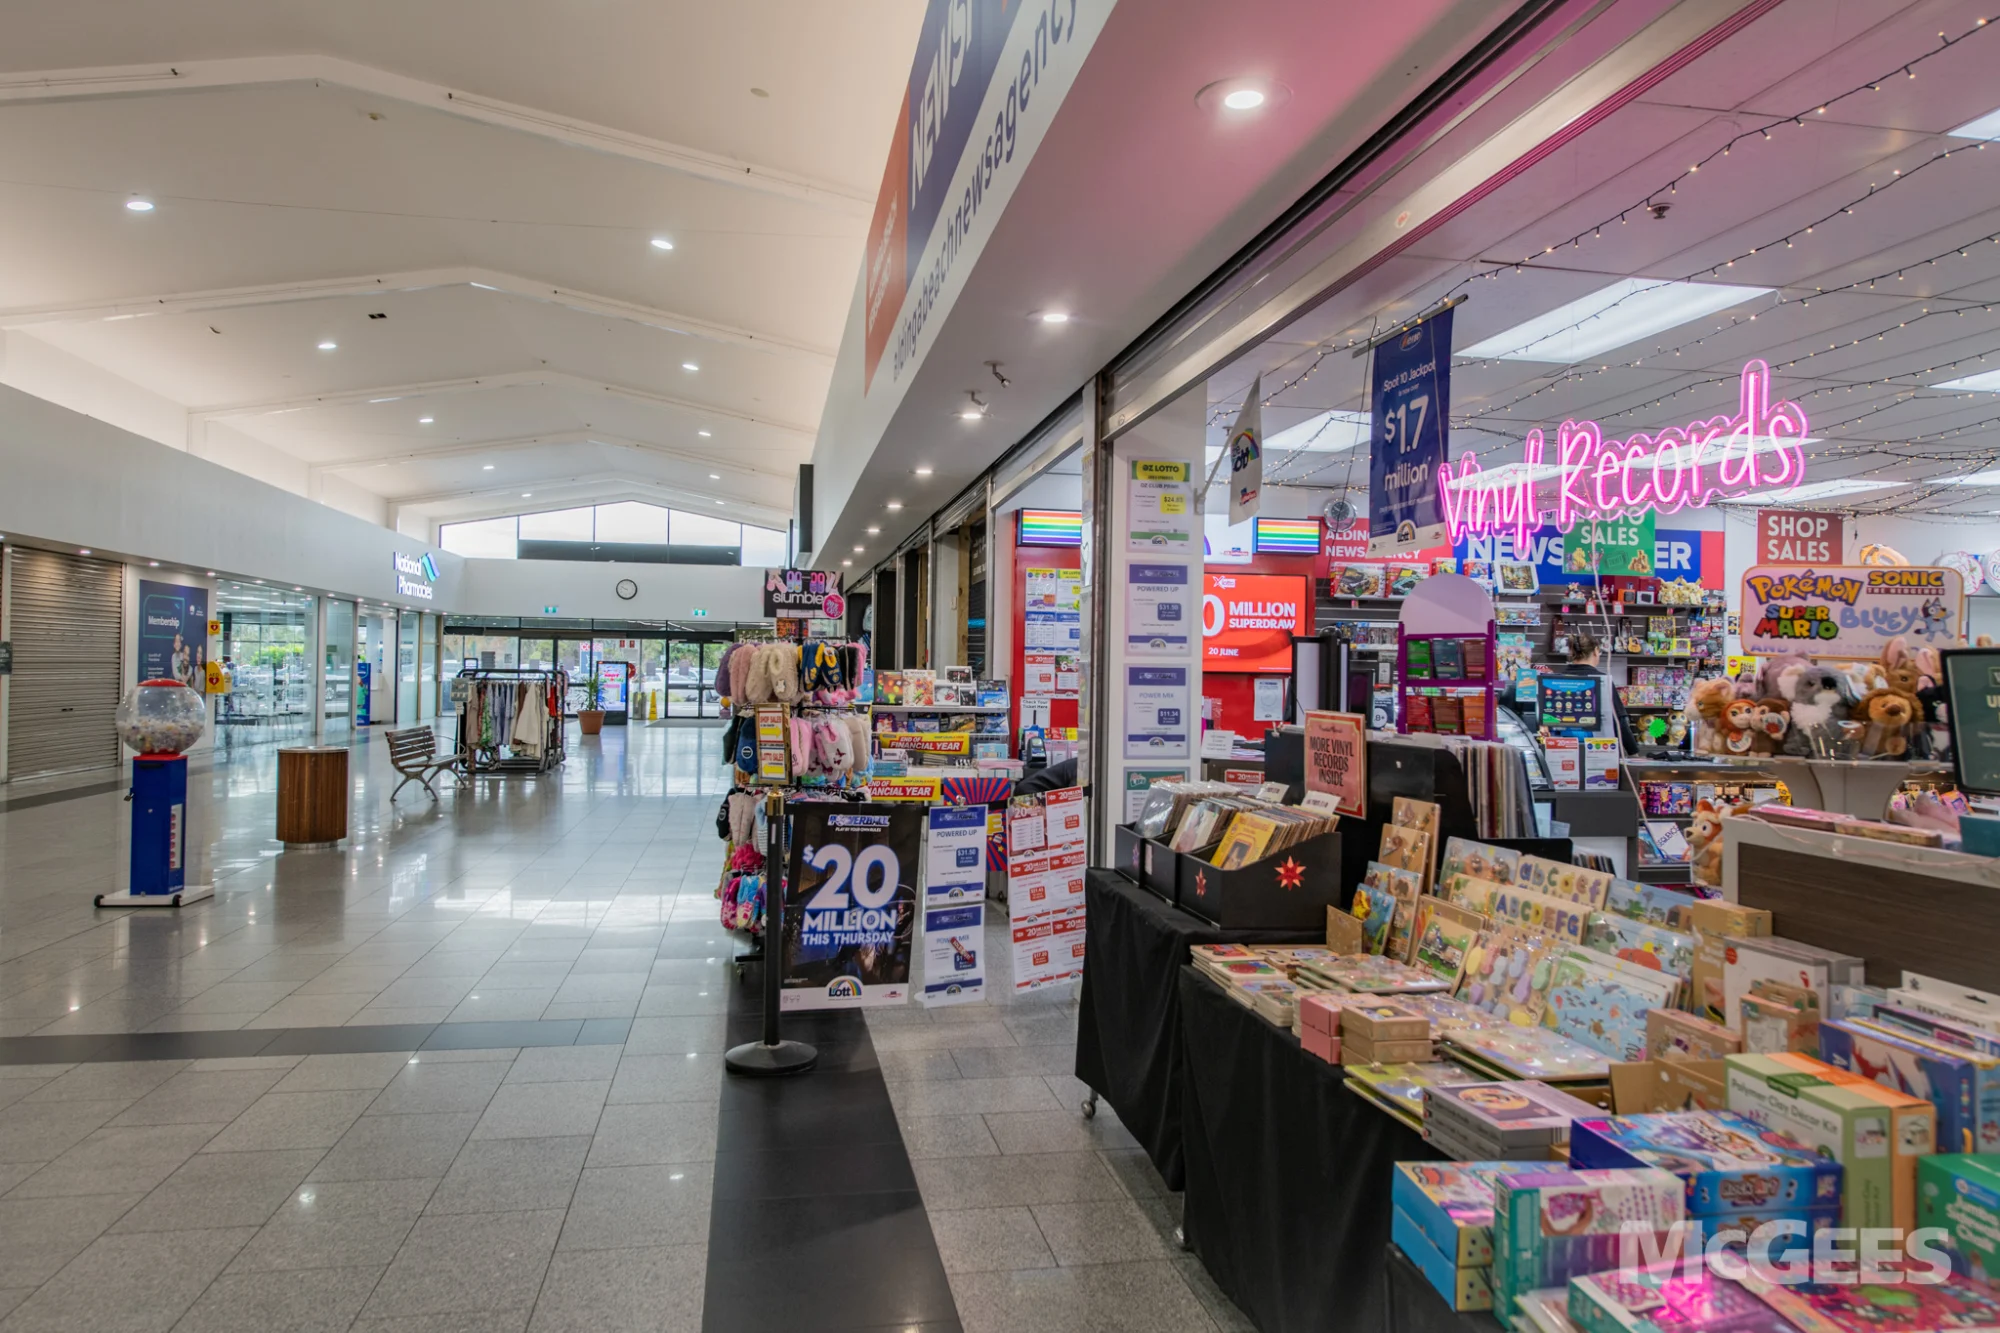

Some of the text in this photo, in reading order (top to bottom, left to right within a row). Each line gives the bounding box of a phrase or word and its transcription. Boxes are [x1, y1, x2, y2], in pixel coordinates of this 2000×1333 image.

[1384, 360, 1436, 392] Spot 10 Jackpot
[1384, 394, 1430, 455] $1.7
[1155, 465, 1179, 473] LOTTO
[1439, 367, 1803, 554] Vinyl Records
[1581, 526, 1640, 546] SALES
[1768, 516, 1828, 538] SHOP
[1767, 540, 1830, 562] SALES
[393, 551, 422, 577] National
[397, 575, 433, 600] Pharmacies
[1747, 569, 1945, 606] Pokémon SONIC
[1229, 602, 1296, 617] MILLION
[1766, 604, 1831, 621] SUPER
[148, 615, 180, 630] Membership
[1229, 618, 1296, 630] SUPERDRAW
[1754, 618, 1839, 641] MARIO
[1208, 647, 1239, 657] 20 JUNE
[1373, 713, 1386, 722] 8+
[890, 741, 960, 751] FINANCIAL YEAR
[1310, 736, 1354, 757] MORE VINYL
[1313, 752, 1349, 772] RECORDS
[1319, 768, 1345, 787] INSIDE
[870, 787, 931, 796] ANCIAL YEAR
[827, 814, 891, 826] POWERBALL
[936, 830, 967, 838] POWERED
[802, 843, 900, 910] $20
[802, 909, 898, 932] MILLION
[802, 931, 895, 946] THIS THURSDAY
[1731, 1078, 1767, 1103] Polymer
[1769, 1094, 1789, 1116] Clay
[1821, 1119, 1838, 1135] Kit
